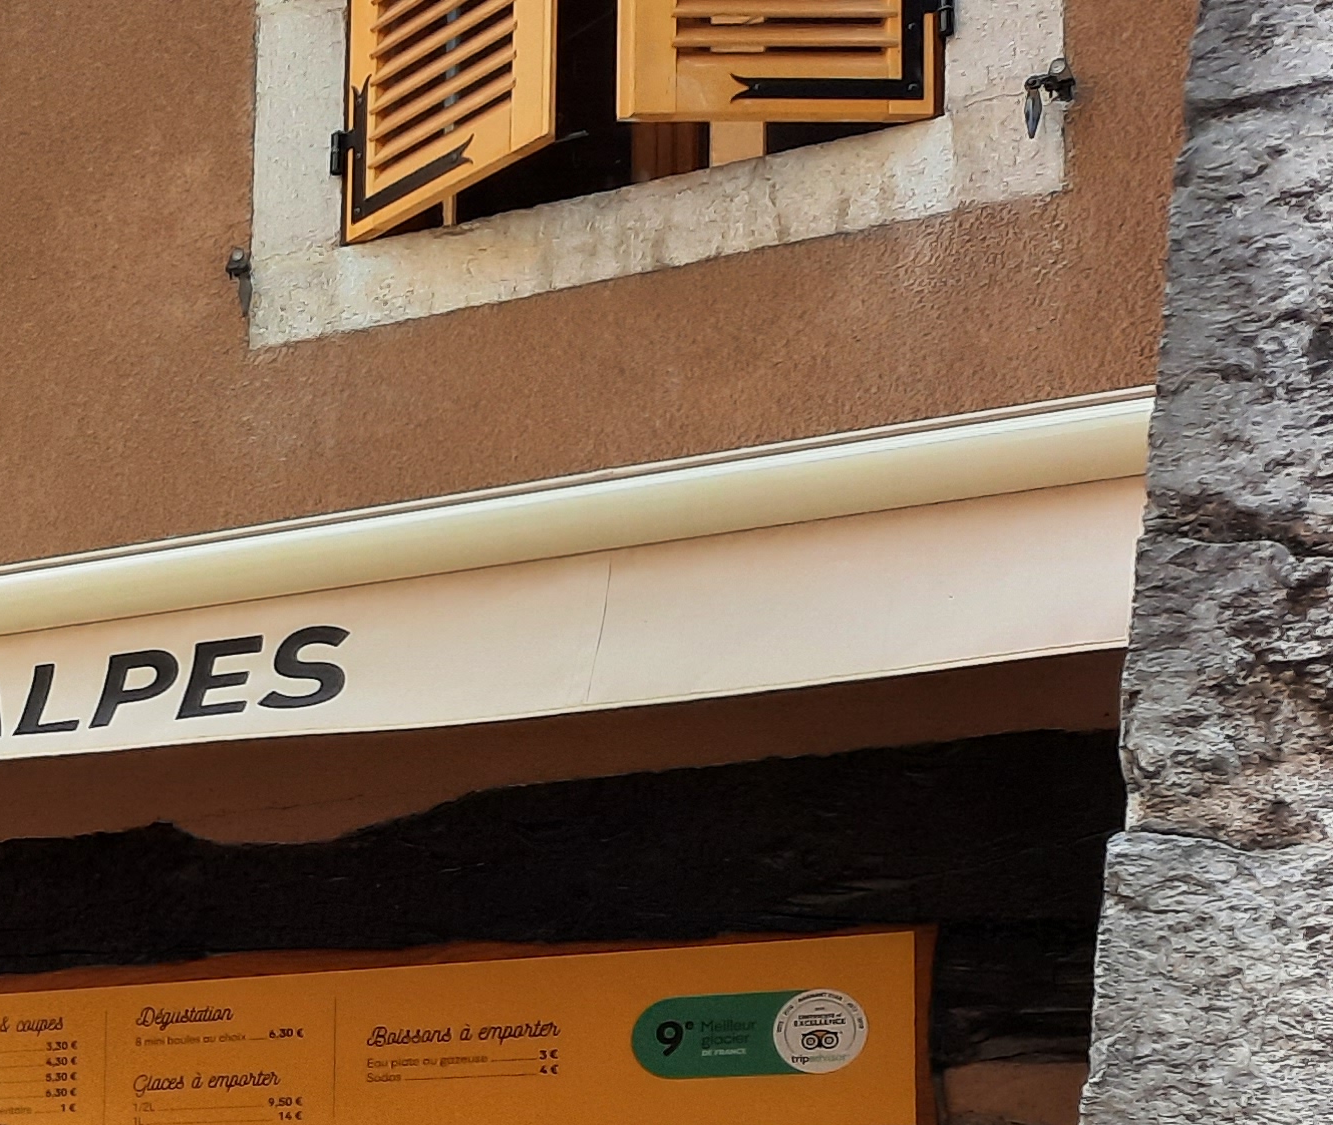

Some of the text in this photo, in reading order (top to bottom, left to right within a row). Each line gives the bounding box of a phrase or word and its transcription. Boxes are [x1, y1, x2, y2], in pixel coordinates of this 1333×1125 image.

[16, 1016, 64, 1037] coupes
[135, 1005, 234, 1031] Dégustation
[296, 1028, 304, 1038] €
[367, 1020, 561, 1047] Boissons à emporter
[367, 1058, 388, 1069] Eau
[423, 1058, 437, 1066] ou
[539, 1050, 547, 1060] 3
[550, 1049, 559, 1059] €
[539, 1065, 548, 1074] 4
[550, 1064, 559, 1074] €
[133, 1071, 281, 1098] Glaces à emporter
[295, 1096, 303, 1106] €
[278, 1111, 292, 1120] 14
[295, 1111, 303, 1120] €
